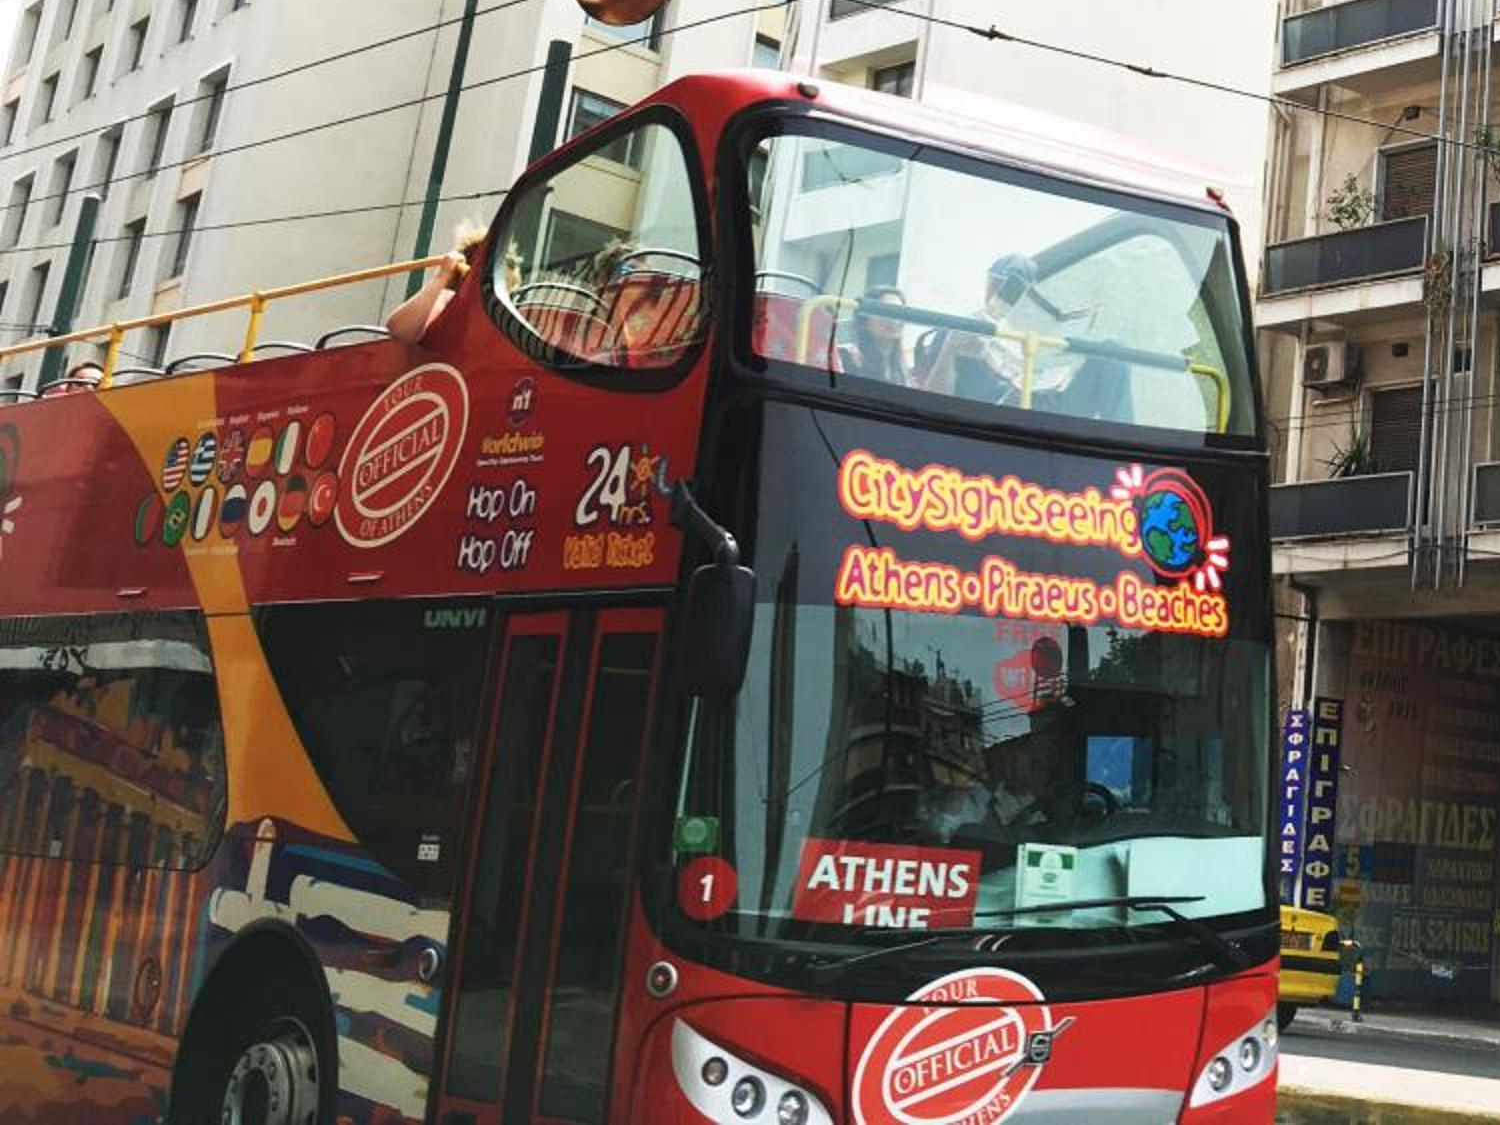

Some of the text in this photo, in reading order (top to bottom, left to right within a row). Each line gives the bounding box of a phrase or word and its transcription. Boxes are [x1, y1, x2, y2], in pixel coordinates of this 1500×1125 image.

[359, 418, 441, 487] OFFICIAL
[576, 446, 630, 525] 24
[467, 480, 536, 523] Hop On
[839, 449, 1142, 555] CitySightseeing
[458, 531, 535, 573] Hop Off
[424, 607, 487, 628] UNVI
[839, 547, 1229, 635] Athens Piraeus Beaches
[1280, 714, 1305, 873] ΣΦΡΑΓΙΔΕΣ
[1305, 702, 1340, 906] ΕΠΙΓΡΑΦΕ
[700, 874, 714, 901] 1
[807, 855, 971, 899] ATHENS
[893, 1027, 1016, 1094] OFFICIAL
